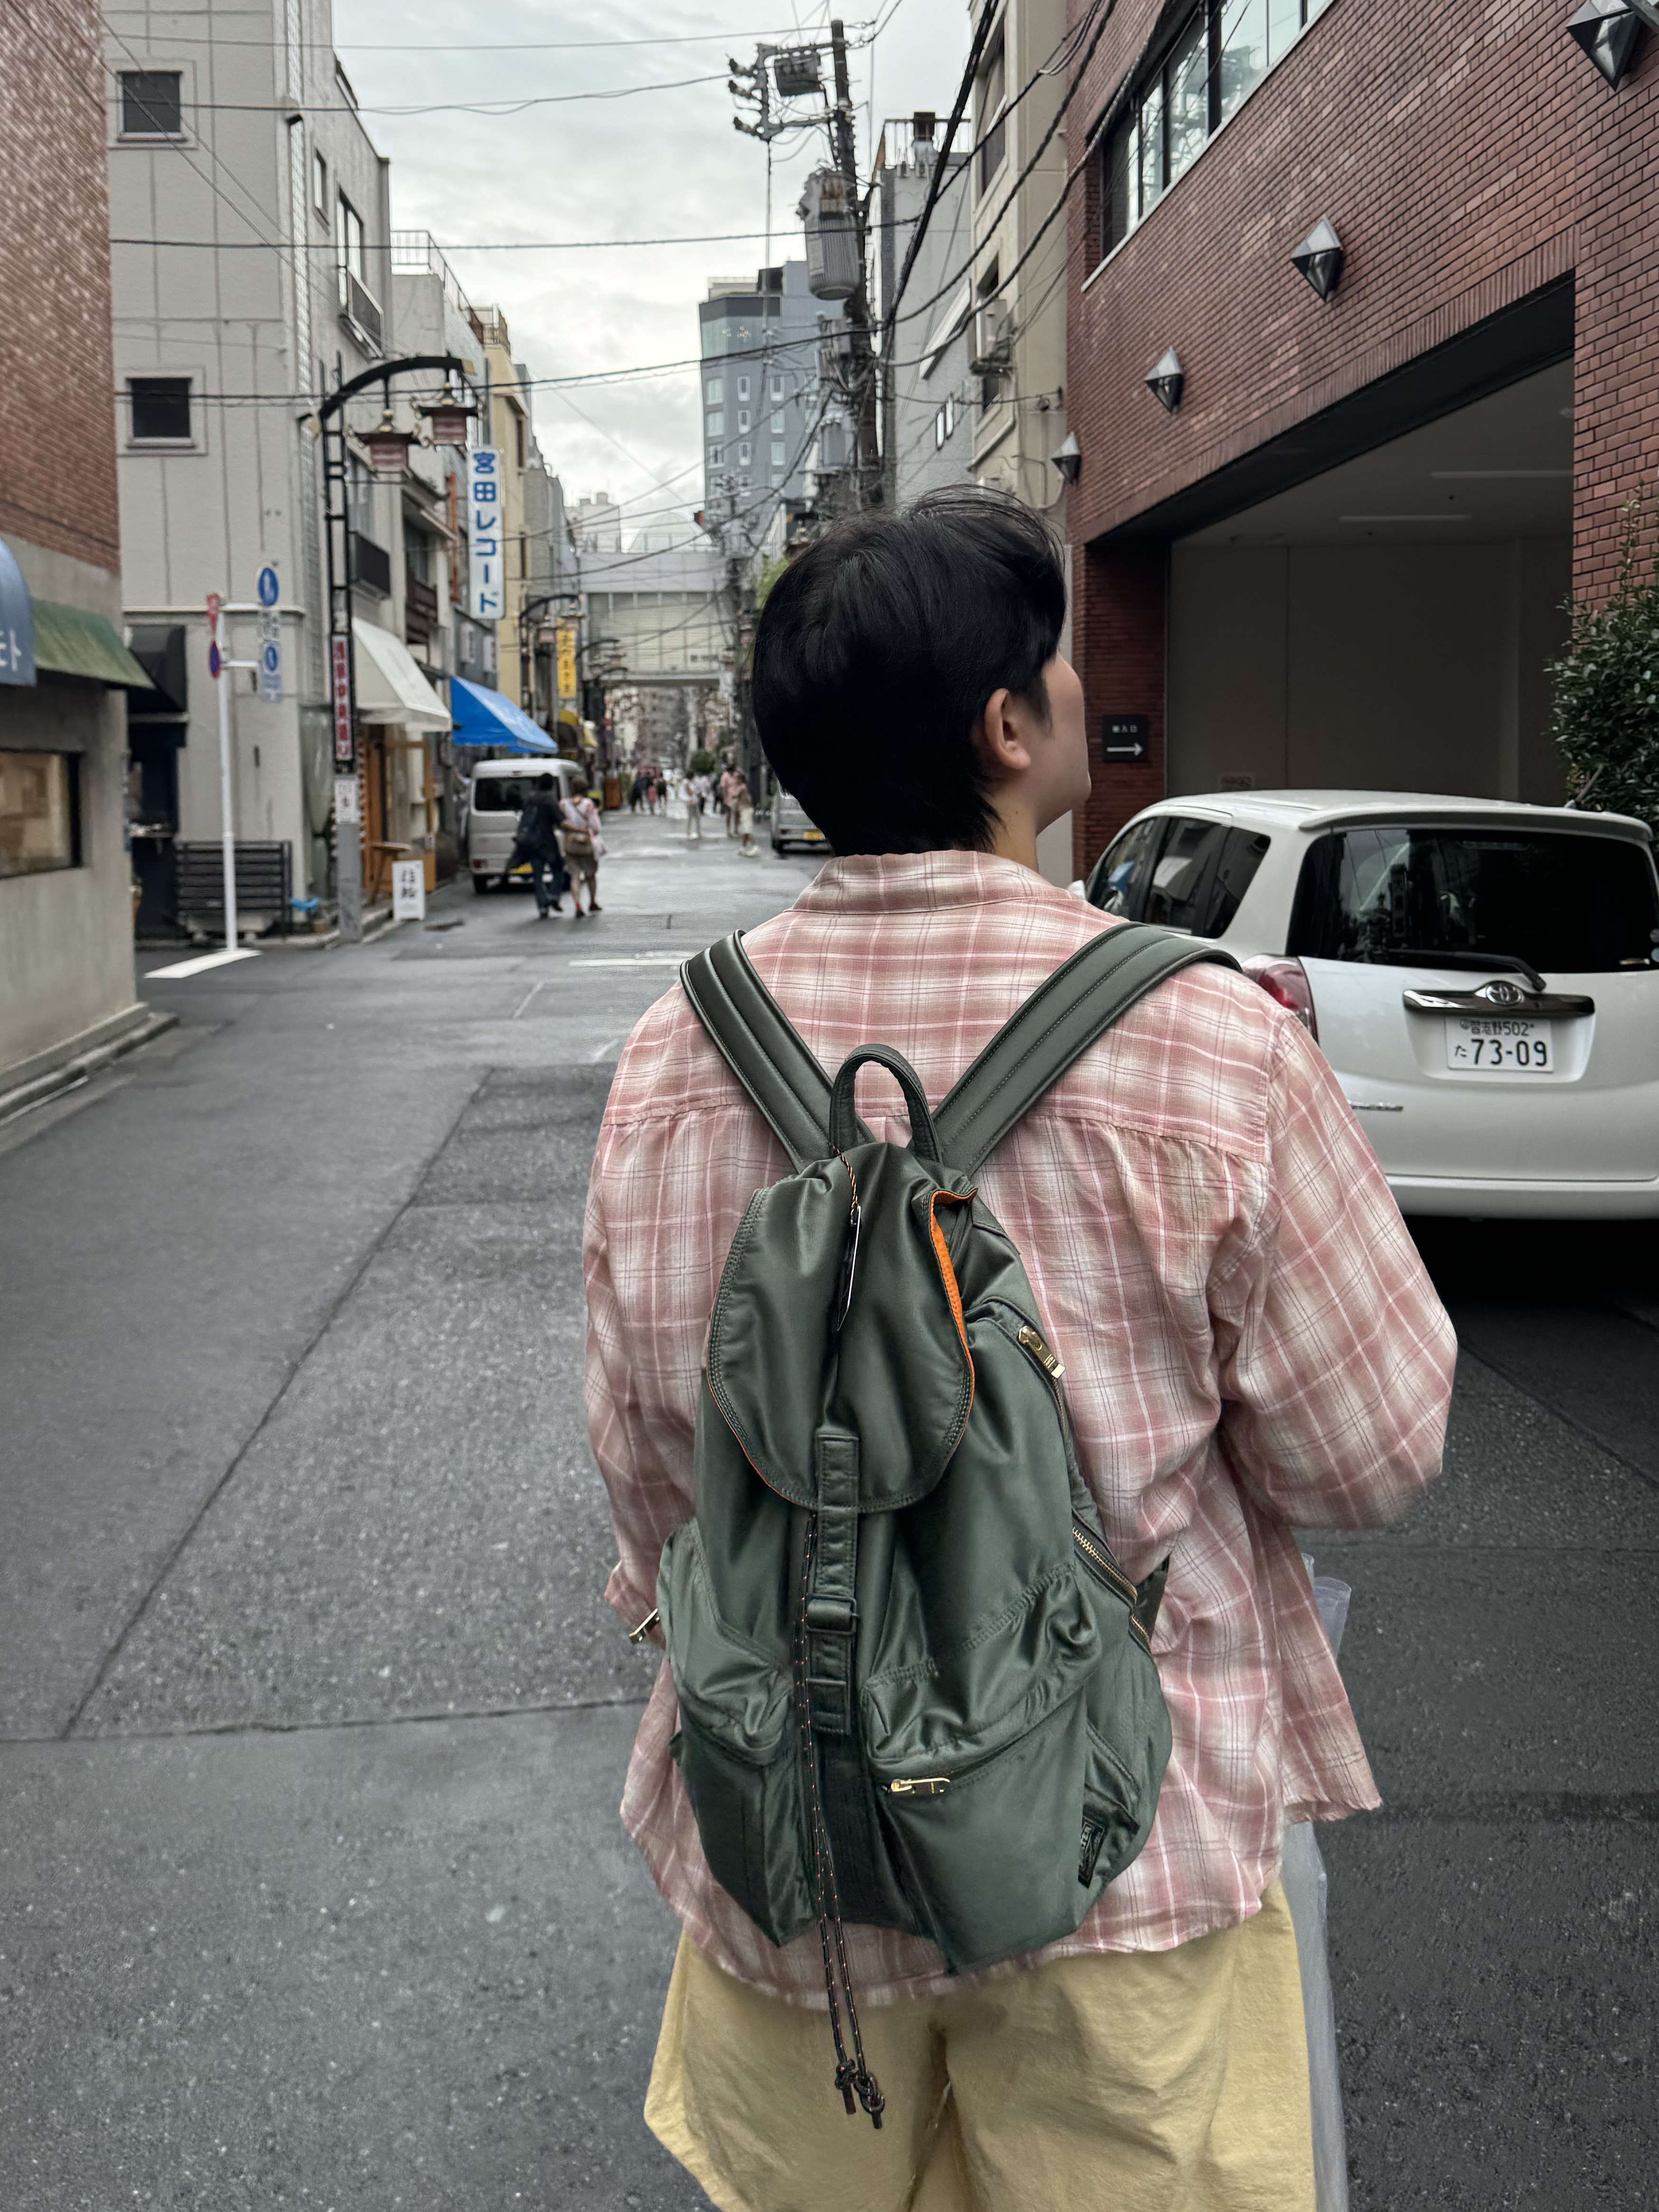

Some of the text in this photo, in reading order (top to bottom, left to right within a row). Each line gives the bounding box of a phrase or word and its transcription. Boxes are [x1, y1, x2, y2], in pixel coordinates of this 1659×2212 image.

[473, 452, 498, 613] 宮田レコード
[1472, 1038, 1547, 1066] 73-09
